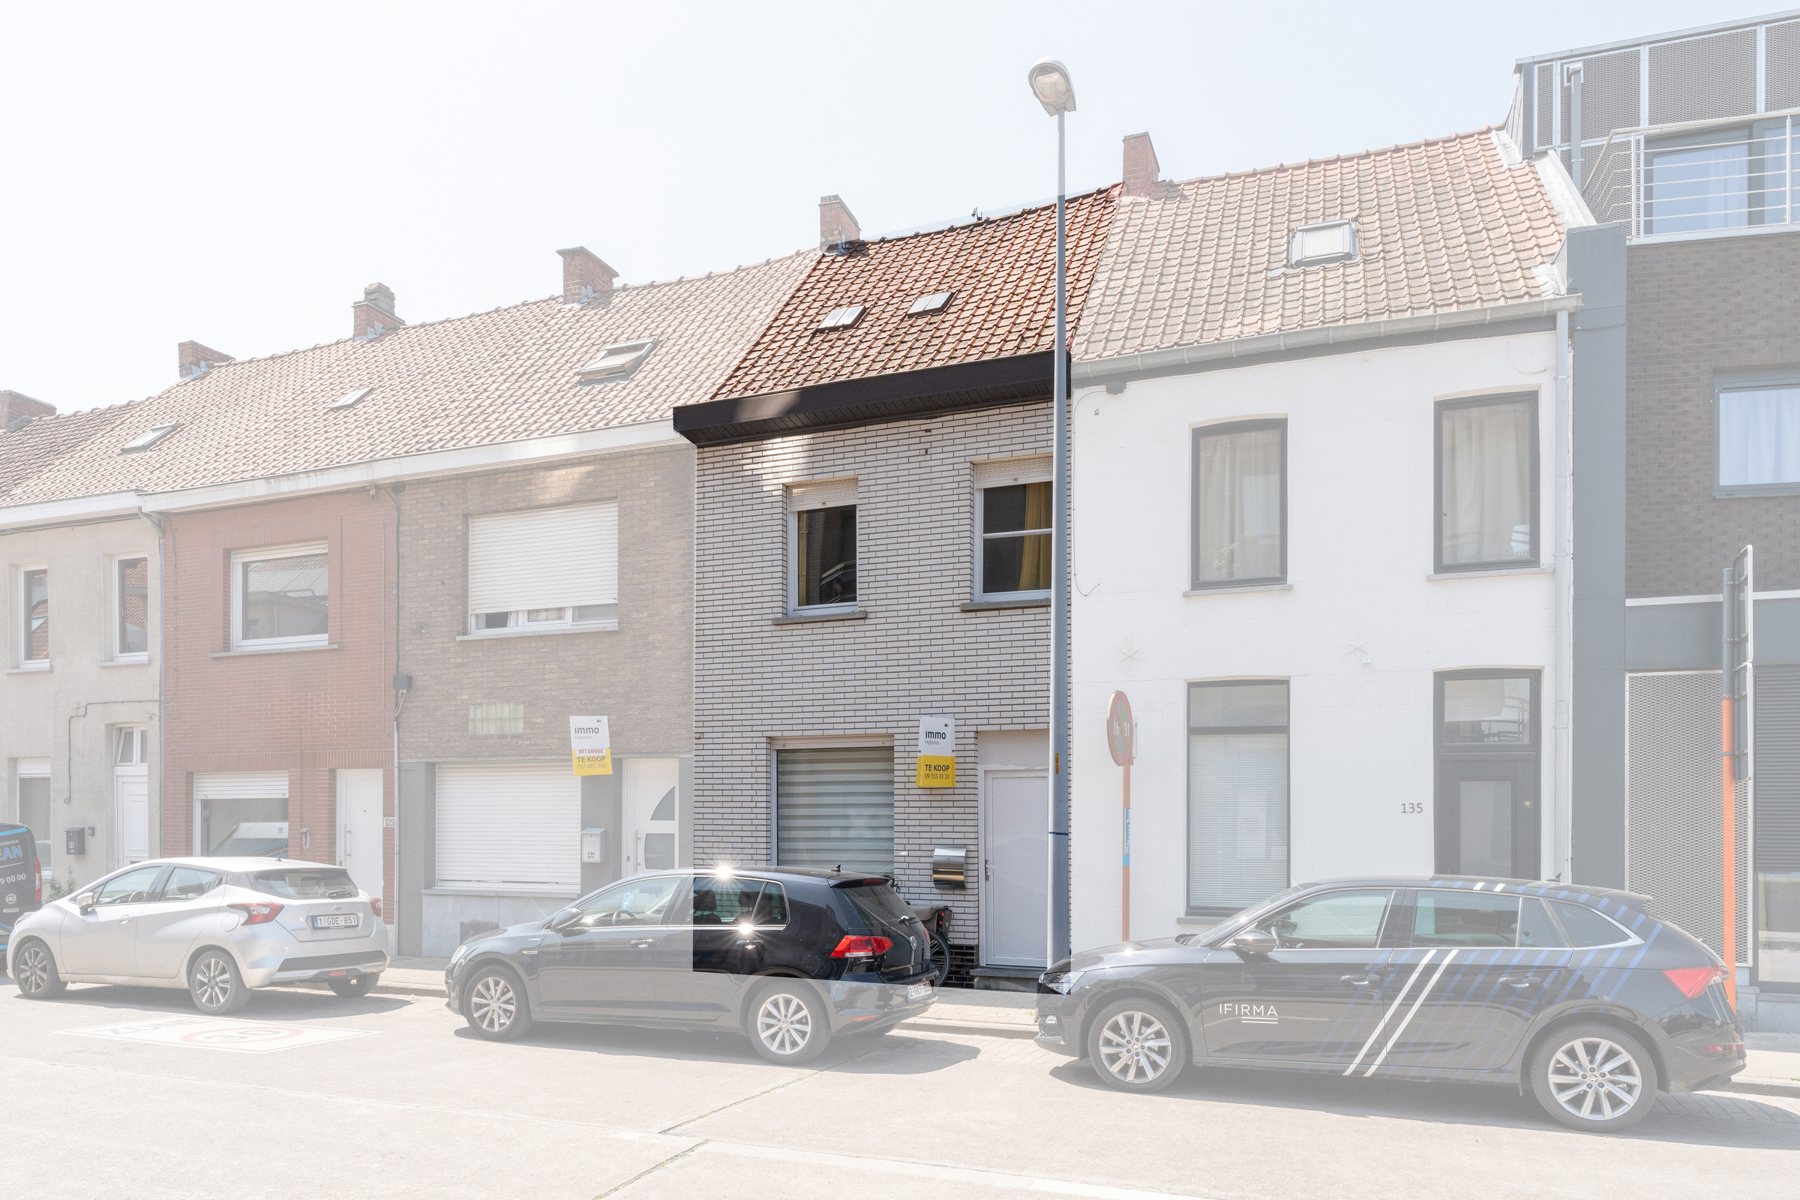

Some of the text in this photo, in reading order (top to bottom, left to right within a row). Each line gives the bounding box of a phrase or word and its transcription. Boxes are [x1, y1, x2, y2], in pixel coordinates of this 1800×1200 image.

[574, 725, 600, 734] immo
[925, 728, 947, 739] immo
[1113, 721, 1130, 737] 16 31
[933, 764, 950, 772] KOOP
[1401, 803, 1423, 814] 135
[6, 875, 16, 884] 00
[16, 872, 27, 881] 00
[1220, 1003, 1278, 1017] IFIRMA
[203, 1029, 282, 1042] 30
